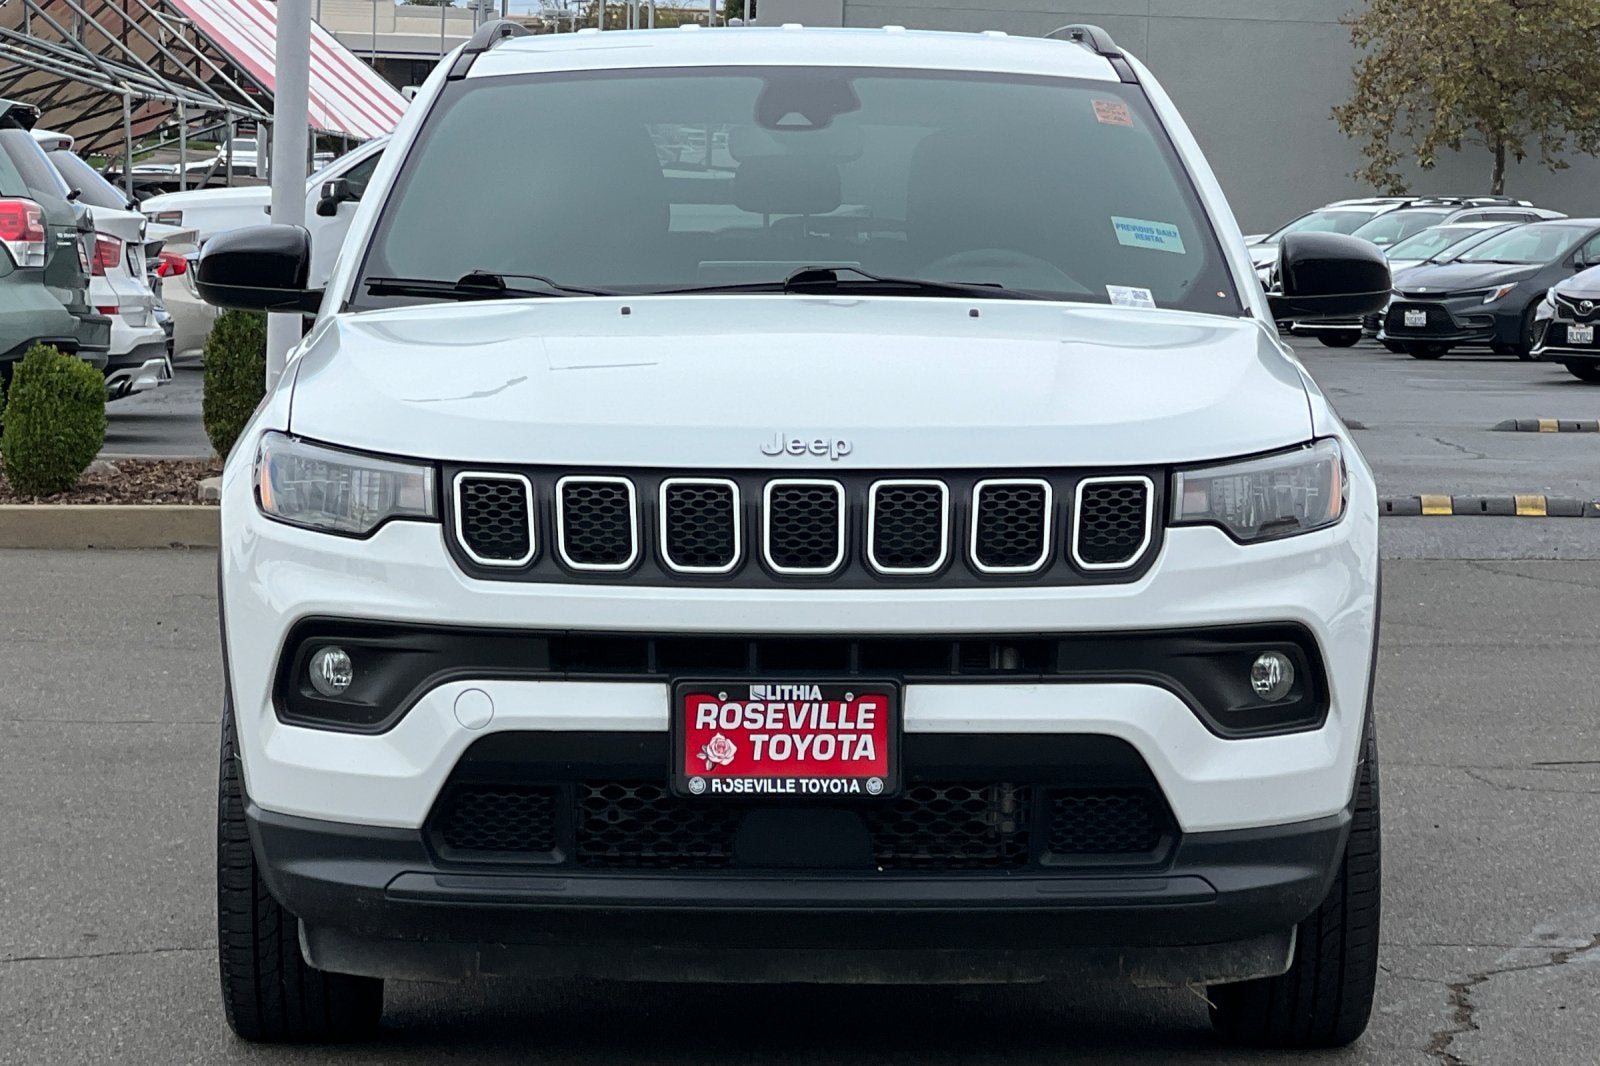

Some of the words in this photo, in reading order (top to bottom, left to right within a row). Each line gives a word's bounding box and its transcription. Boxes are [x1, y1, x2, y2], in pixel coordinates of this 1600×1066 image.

[1115, 222, 1155, 235] PREVIOUS
[1156, 228, 1177, 238] DAILY
[1134, 232, 1165, 244] RENTAL
[760, 431, 853, 461] Jeep
[766, 685, 822, 700] LITHIA
[695, 703, 876, 730] ROSEVILLE
[750, 734, 876, 761] TOYOTA
[711, 779, 796, 793] ROSEVILLE
[800, 779, 860, 793] TOYOTA
